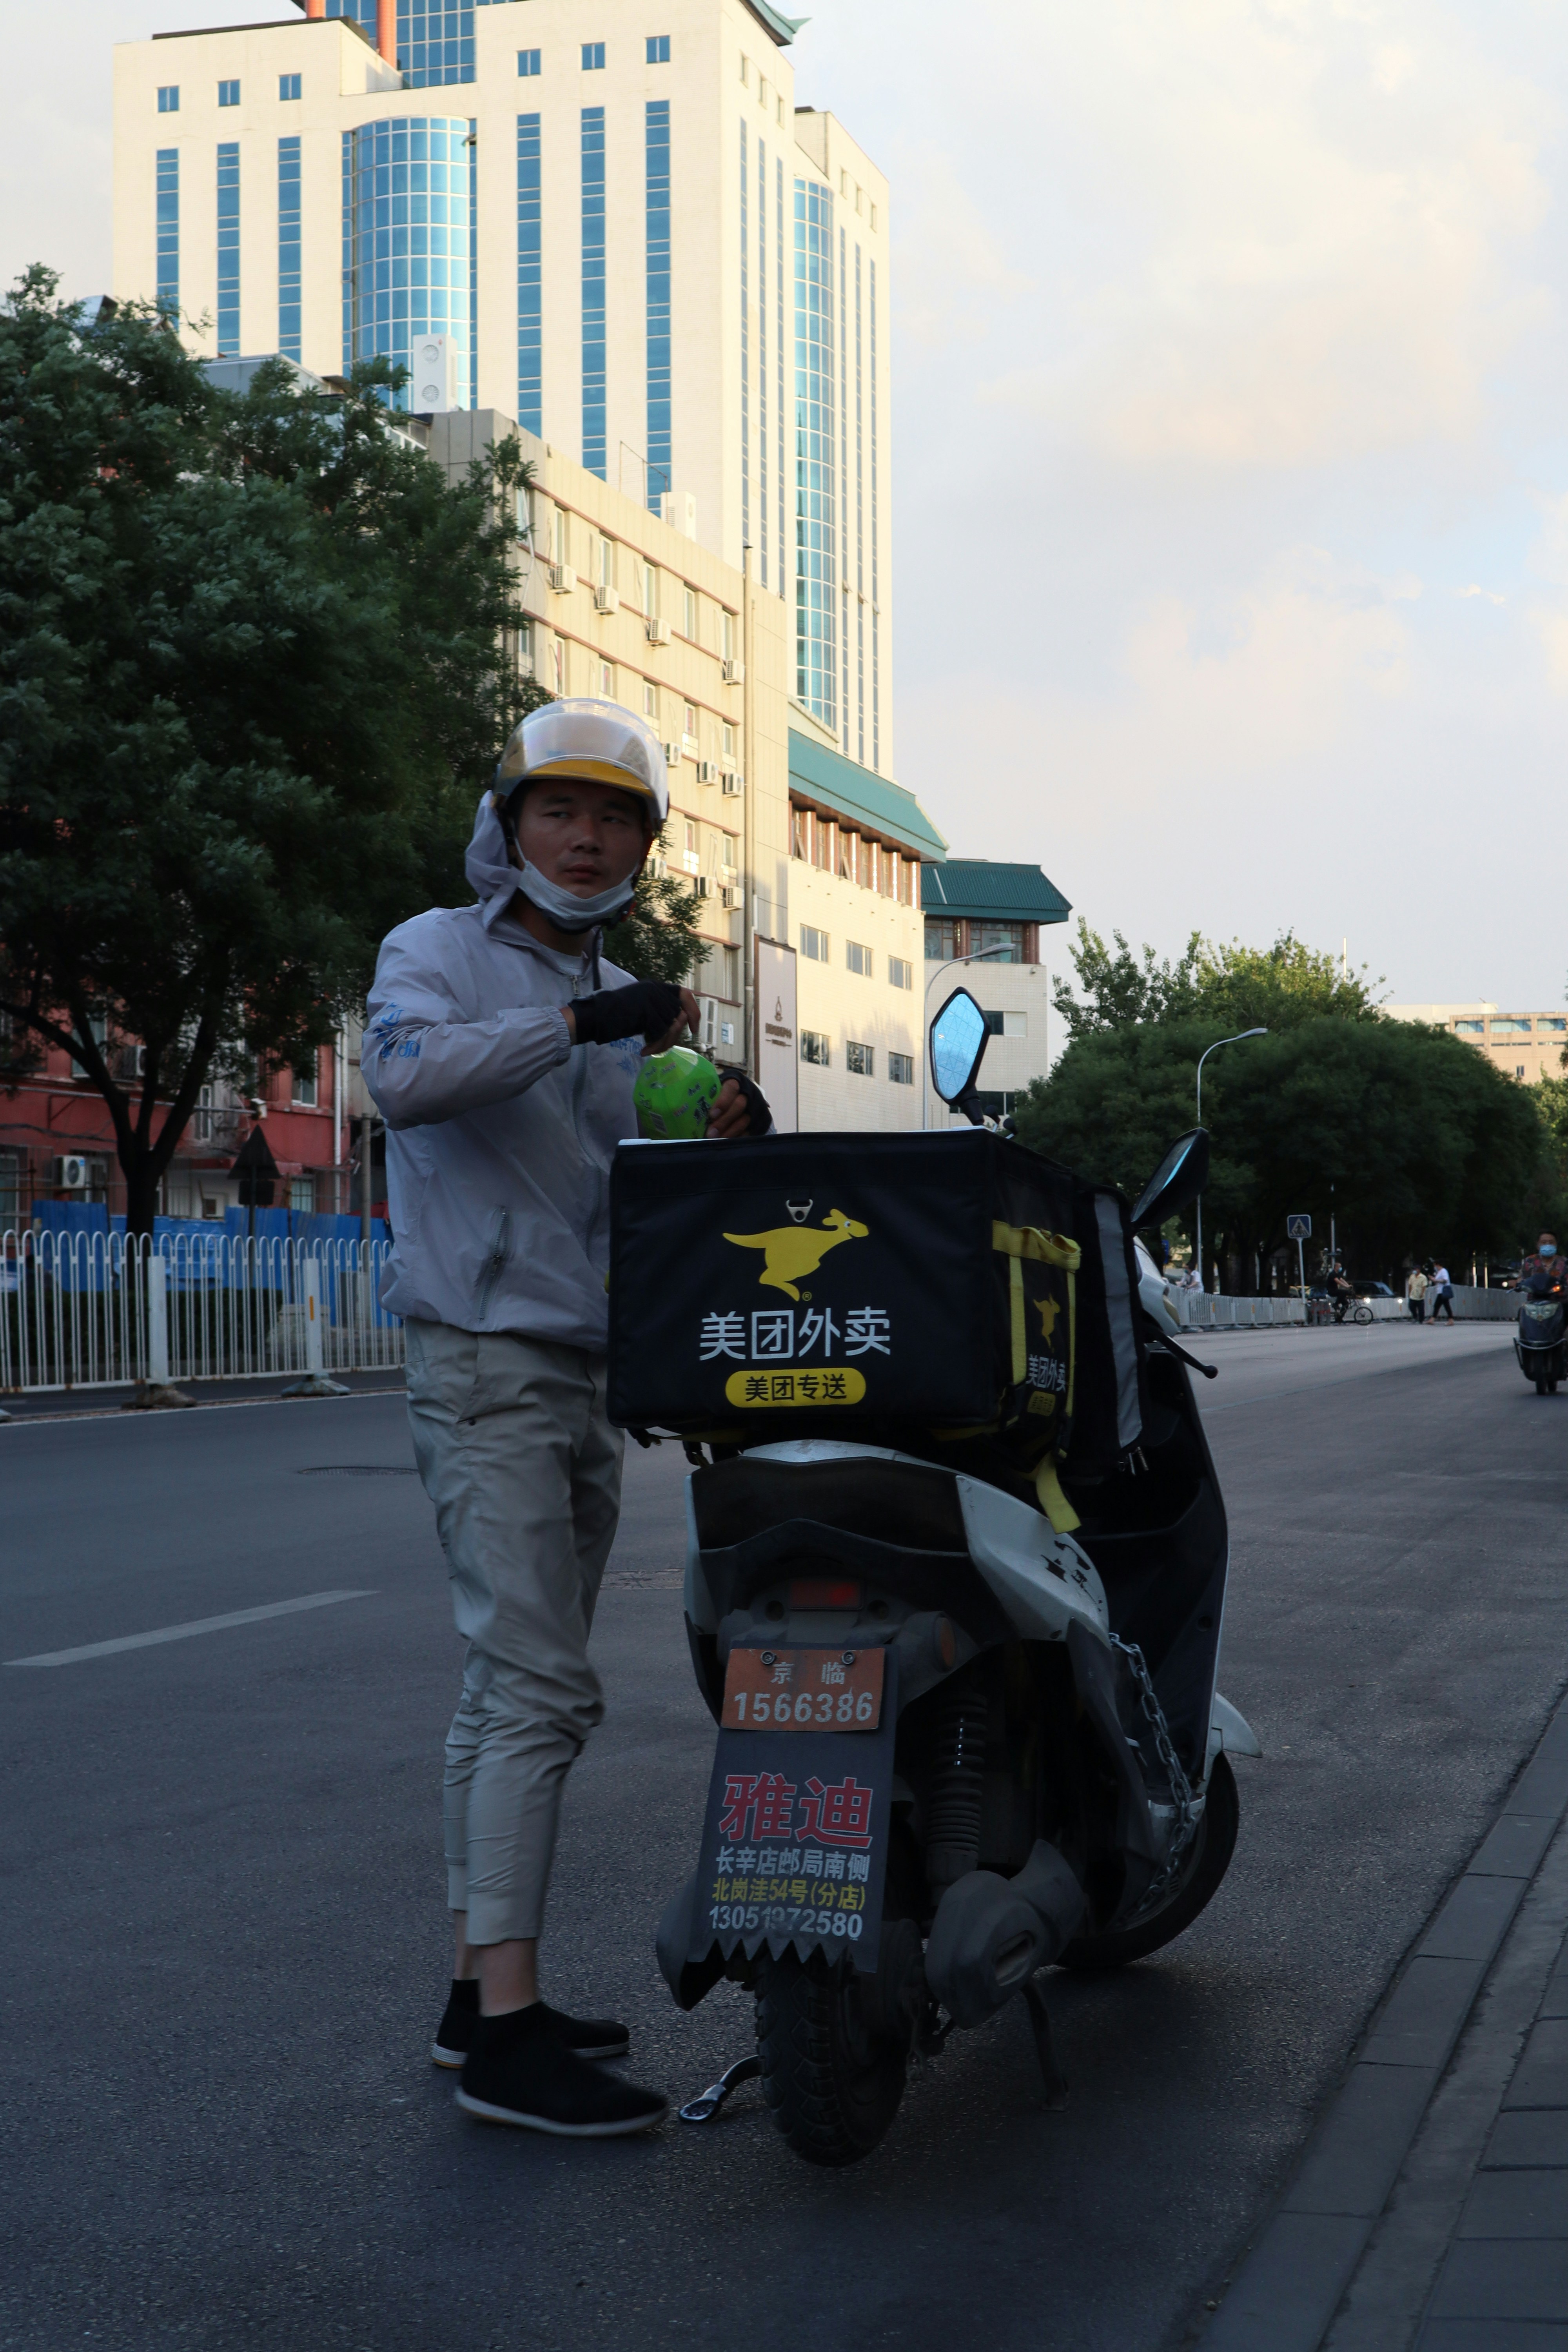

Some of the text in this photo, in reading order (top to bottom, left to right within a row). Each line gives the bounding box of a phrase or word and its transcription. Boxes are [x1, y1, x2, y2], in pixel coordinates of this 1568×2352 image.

[699, 1306, 891, 1361] 美团外卖
[745, 1373, 847, 1402] 美团专送
[770, 1661, 846, 1685] 京 临
[734, 1691, 874, 1723] 1566386
[719, 1771, 873, 1849] 雅迪
[715, 1845, 871, 1882] 长辛店邮局南侧
